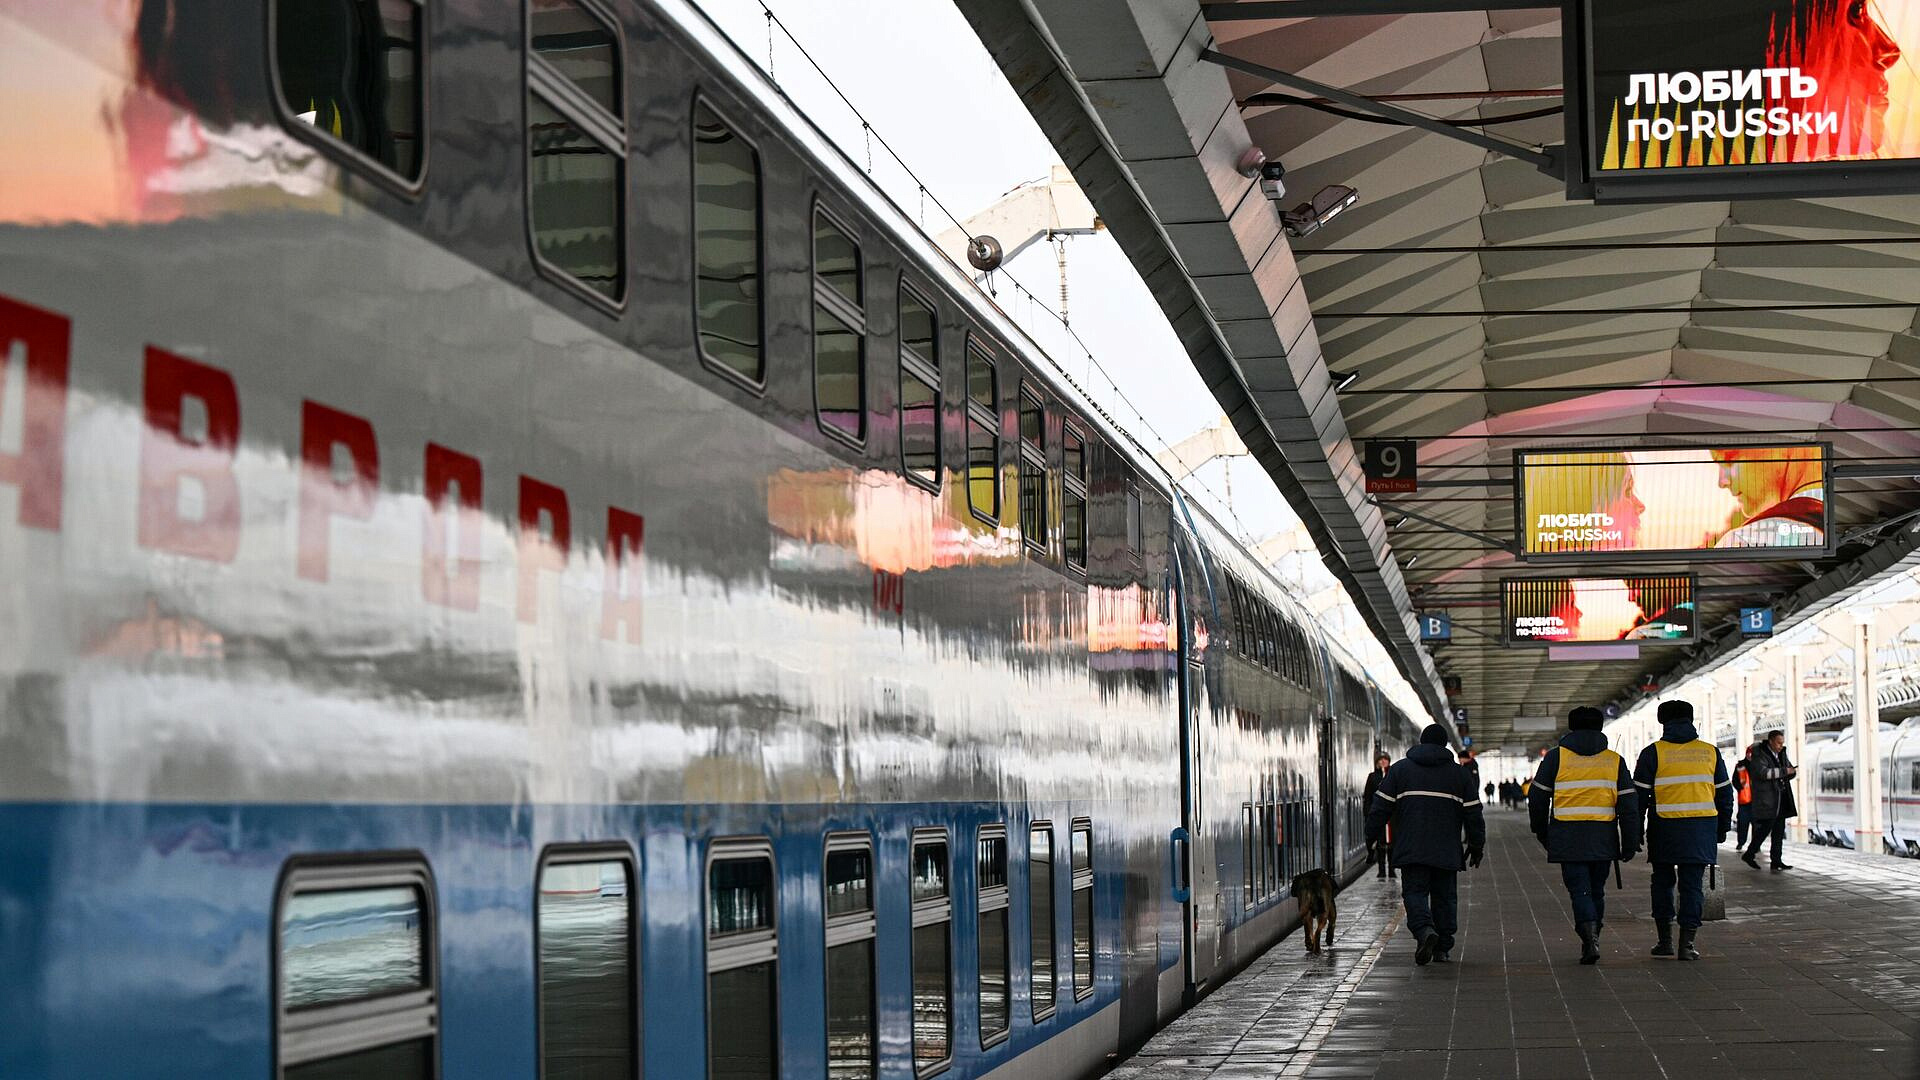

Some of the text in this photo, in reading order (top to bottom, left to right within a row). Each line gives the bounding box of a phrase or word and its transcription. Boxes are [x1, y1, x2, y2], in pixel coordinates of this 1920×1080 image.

[1624, 67, 1818, 105] ЛЮБИТЬ
[1627, 107, 1838, 142] по-RUSSки
[1381, 446, 1401, 478] 9
[1537, 513, 1615, 528] ЛЮБИТЬ
[1538, 528, 1622, 542] по-RUSSки
[1515, 616, 1564, 627] ЛЮБИТЬ
